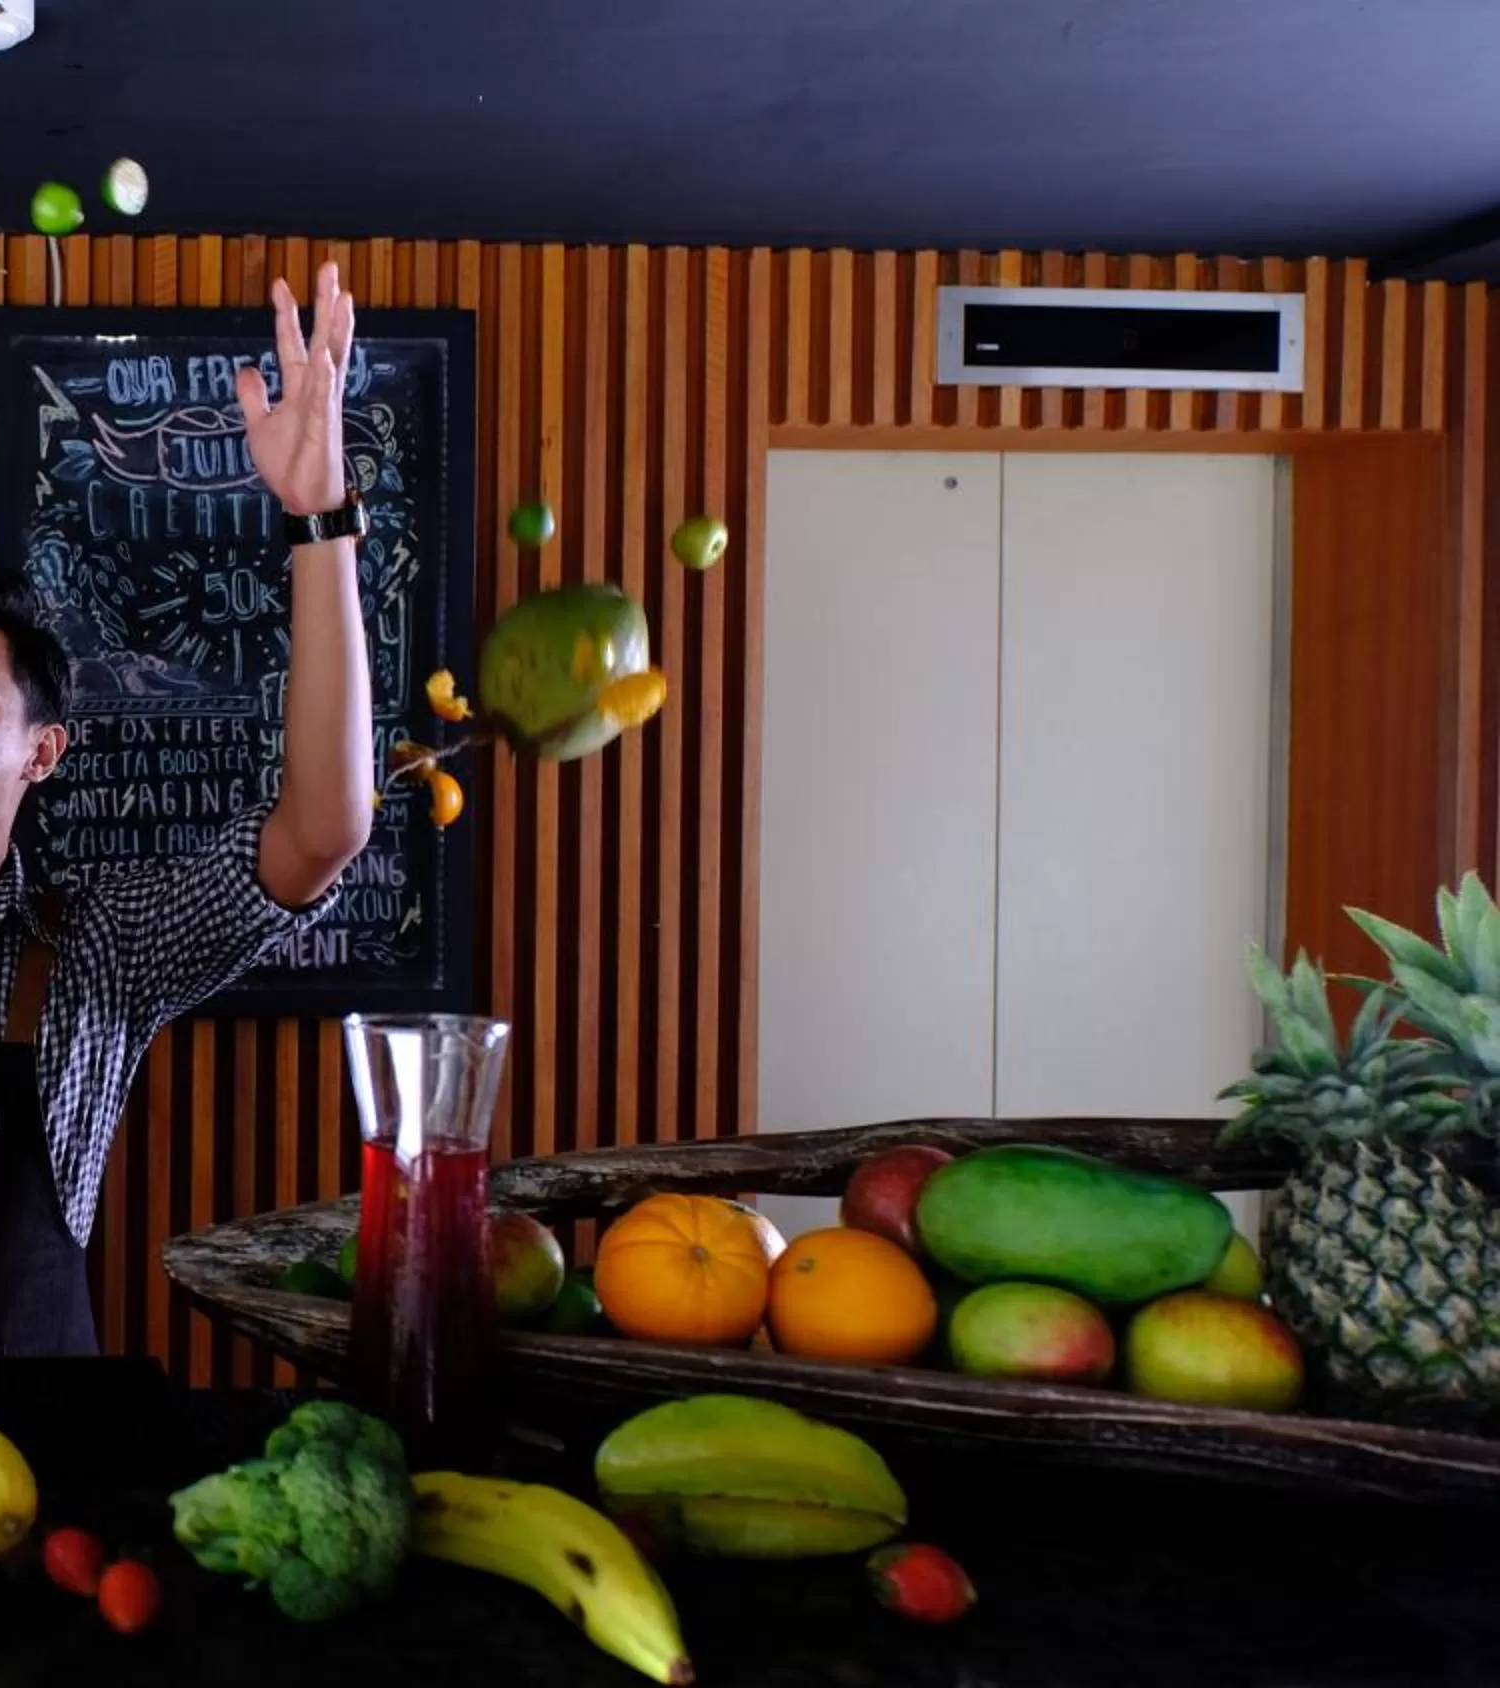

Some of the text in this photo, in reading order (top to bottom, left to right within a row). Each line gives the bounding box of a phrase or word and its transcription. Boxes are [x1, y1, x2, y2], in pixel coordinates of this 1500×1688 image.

[106, 355, 176, 405] OUR
[171, 436, 252, 479] JUI
[87, 480, 272, 541] CREATI
[65, 750, 149, 783] SPECTA
[159, 743, 255, 777] BOOSTER
[64, 825, 140, 858] CAULI
